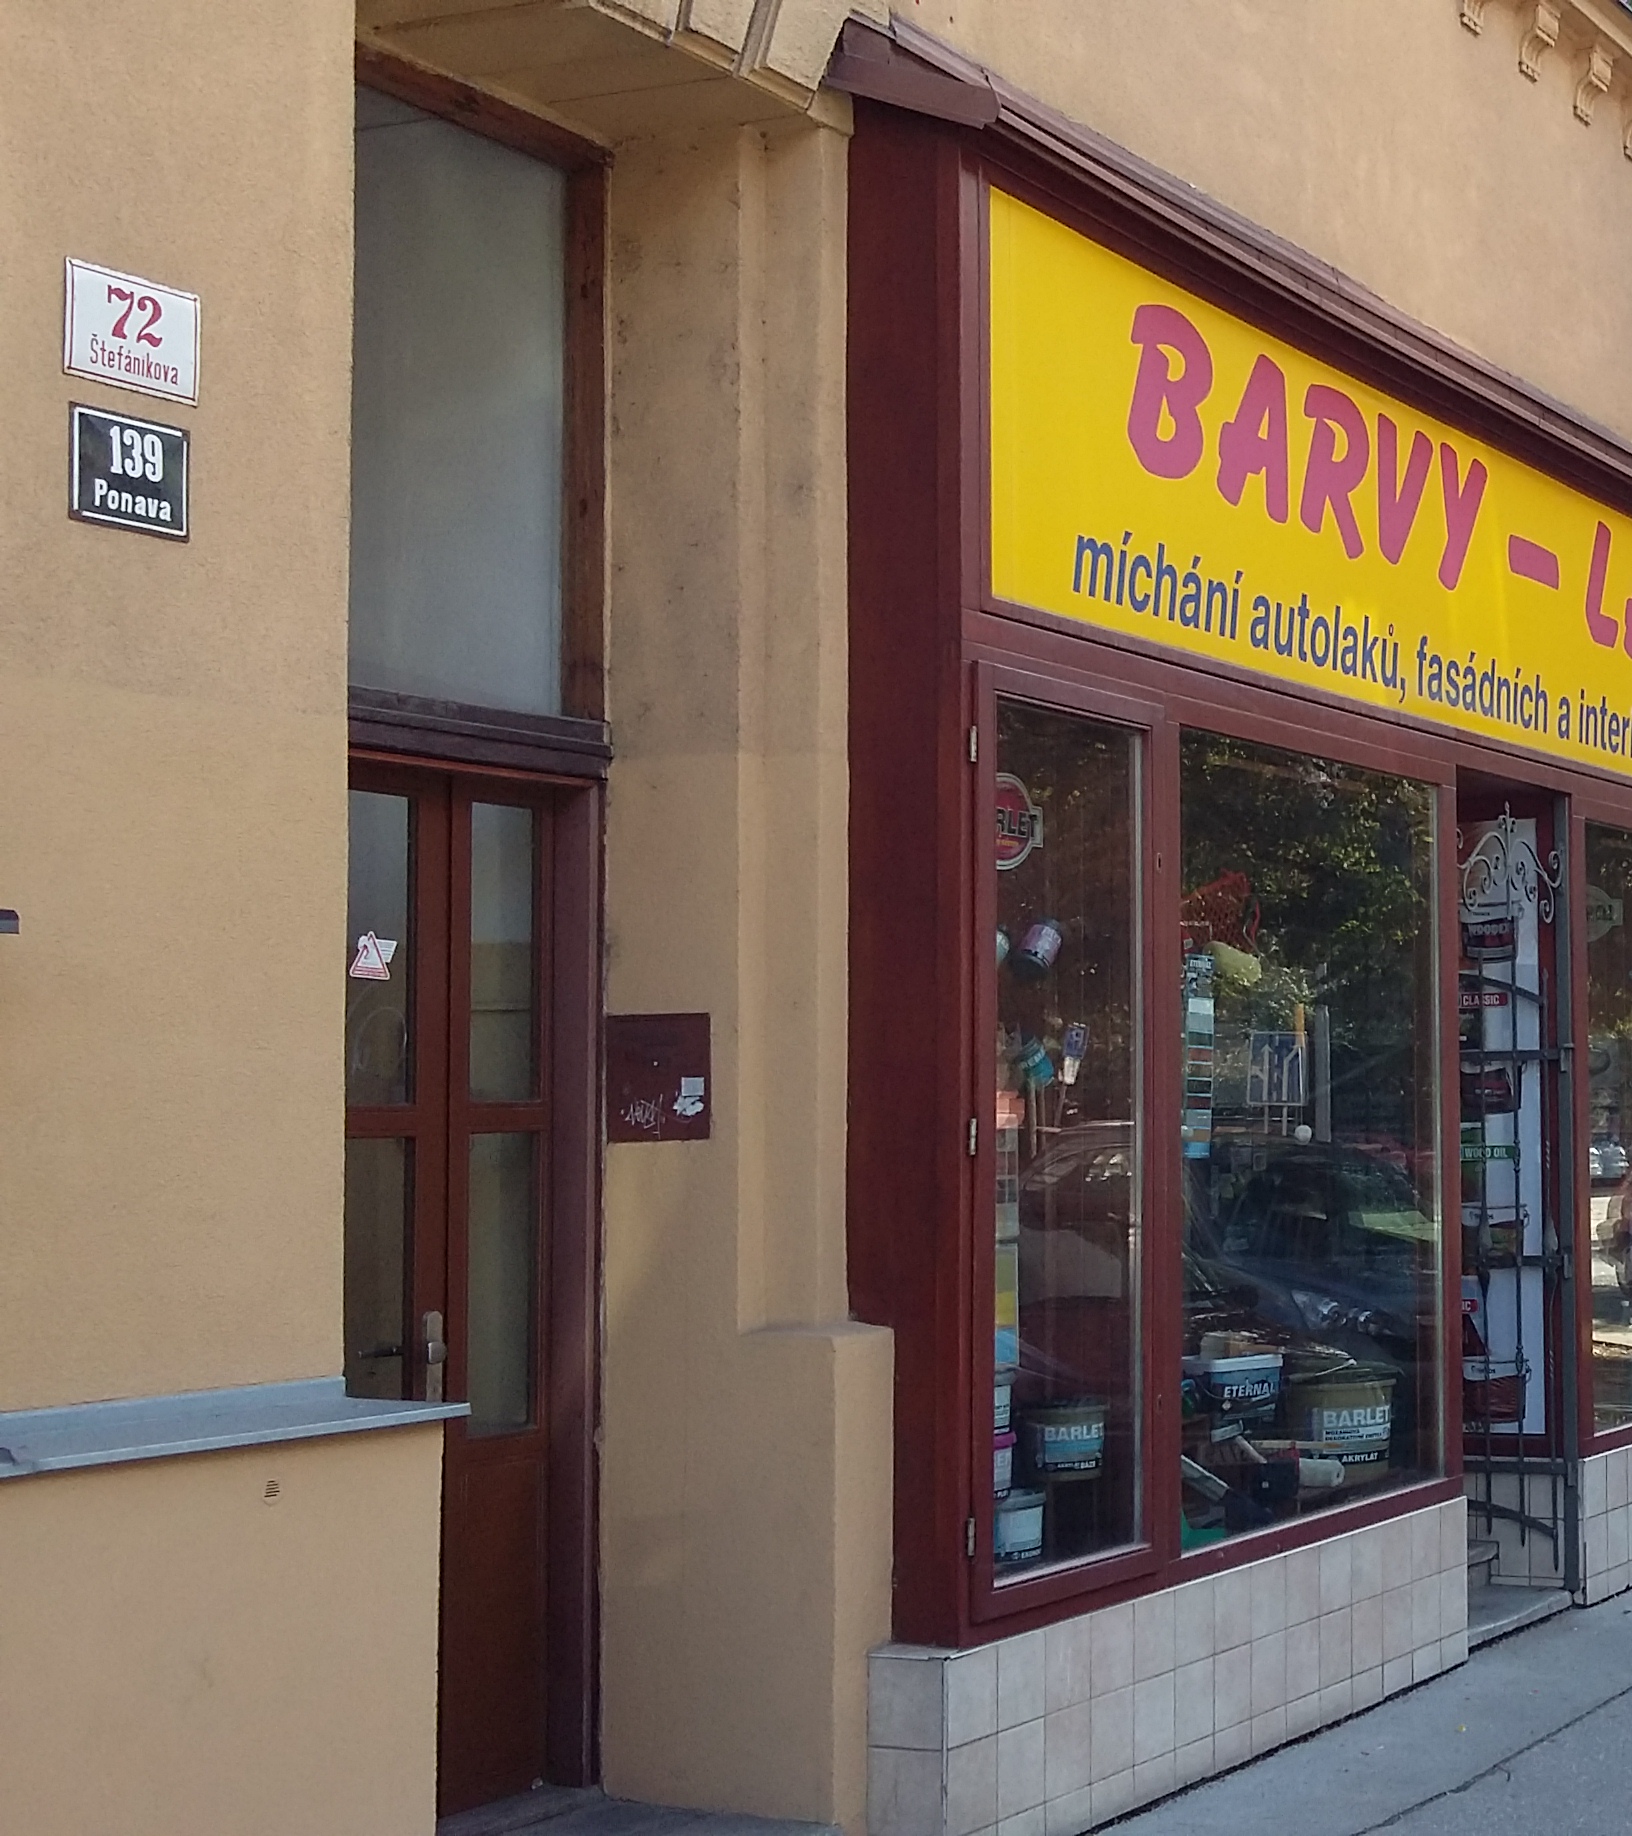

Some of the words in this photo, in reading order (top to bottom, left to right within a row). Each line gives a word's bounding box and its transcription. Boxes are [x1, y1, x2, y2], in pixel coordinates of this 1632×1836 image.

[107, 284, 163, 348] 72
[89, 332, 179, 386] Štefánikova
[109, 425, 164, 483] 139
[1127, 303, 1488, 591] BARVY
[93, 477, 172, 522] Ponava
[1072, 529, 1245, 641] míchání
[1249, 591, 1407, 704] autolaků,
[1416, 635, 1549, 734] fasádních
[1557, 695, 1571, 741] a
[996, 807, 1038, 838] RLET
[1462, 993, 1500, 1006] CLASIC
[1493, 1147, 1508, 1158] OIL
[1223, 1382, 1276, 1398] ETERNAL
[1044, 1421, 1104, 1442] BARLET
[1323, 1405, 1391, 1428] BARLET
